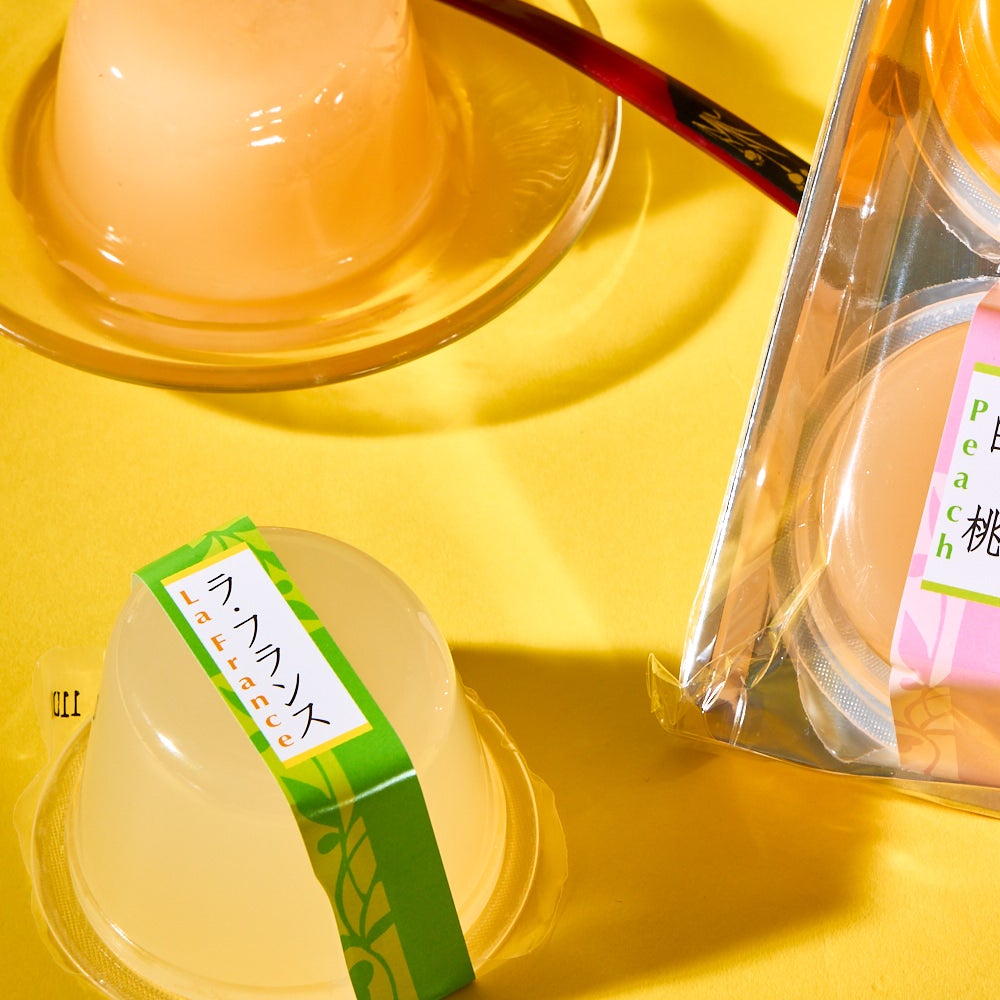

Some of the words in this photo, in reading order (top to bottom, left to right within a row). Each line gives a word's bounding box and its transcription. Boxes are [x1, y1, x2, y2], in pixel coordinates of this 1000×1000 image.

[936, 398, 989, 560] Peach
[179, 589, 213, 625] La
[209, 633, 295, 748] France
[207, 573, 331, 740] ラ・フランス
